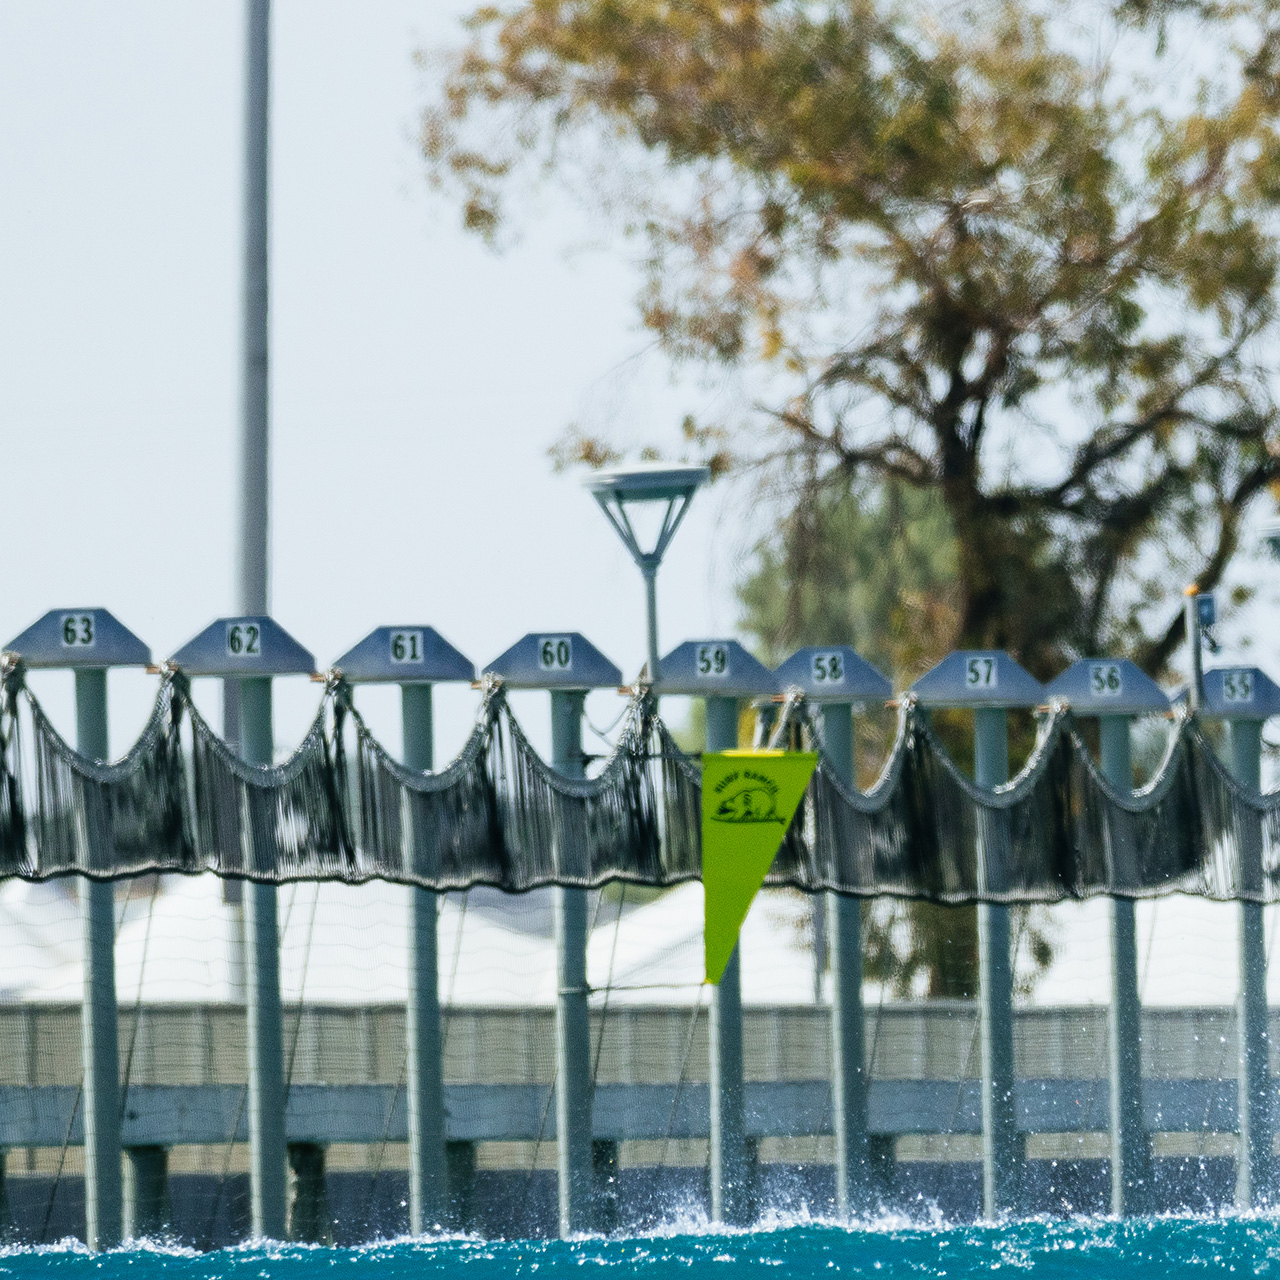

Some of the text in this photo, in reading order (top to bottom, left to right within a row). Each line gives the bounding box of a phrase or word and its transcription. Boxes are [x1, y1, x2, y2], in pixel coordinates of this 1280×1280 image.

[63, 617, 92, 645] 63
[229, 626, 259, 654] 62
[391, 634, 420, 661] 61
[541, 640, 570, 668] 60
[700, 648, 727, 674] 59
[815, 655, 842, 681] 58
[968, 659, 993, 684] 57
[1094, 667, 1120, 691] 56
[1225, 673, 1250, 699] 55
